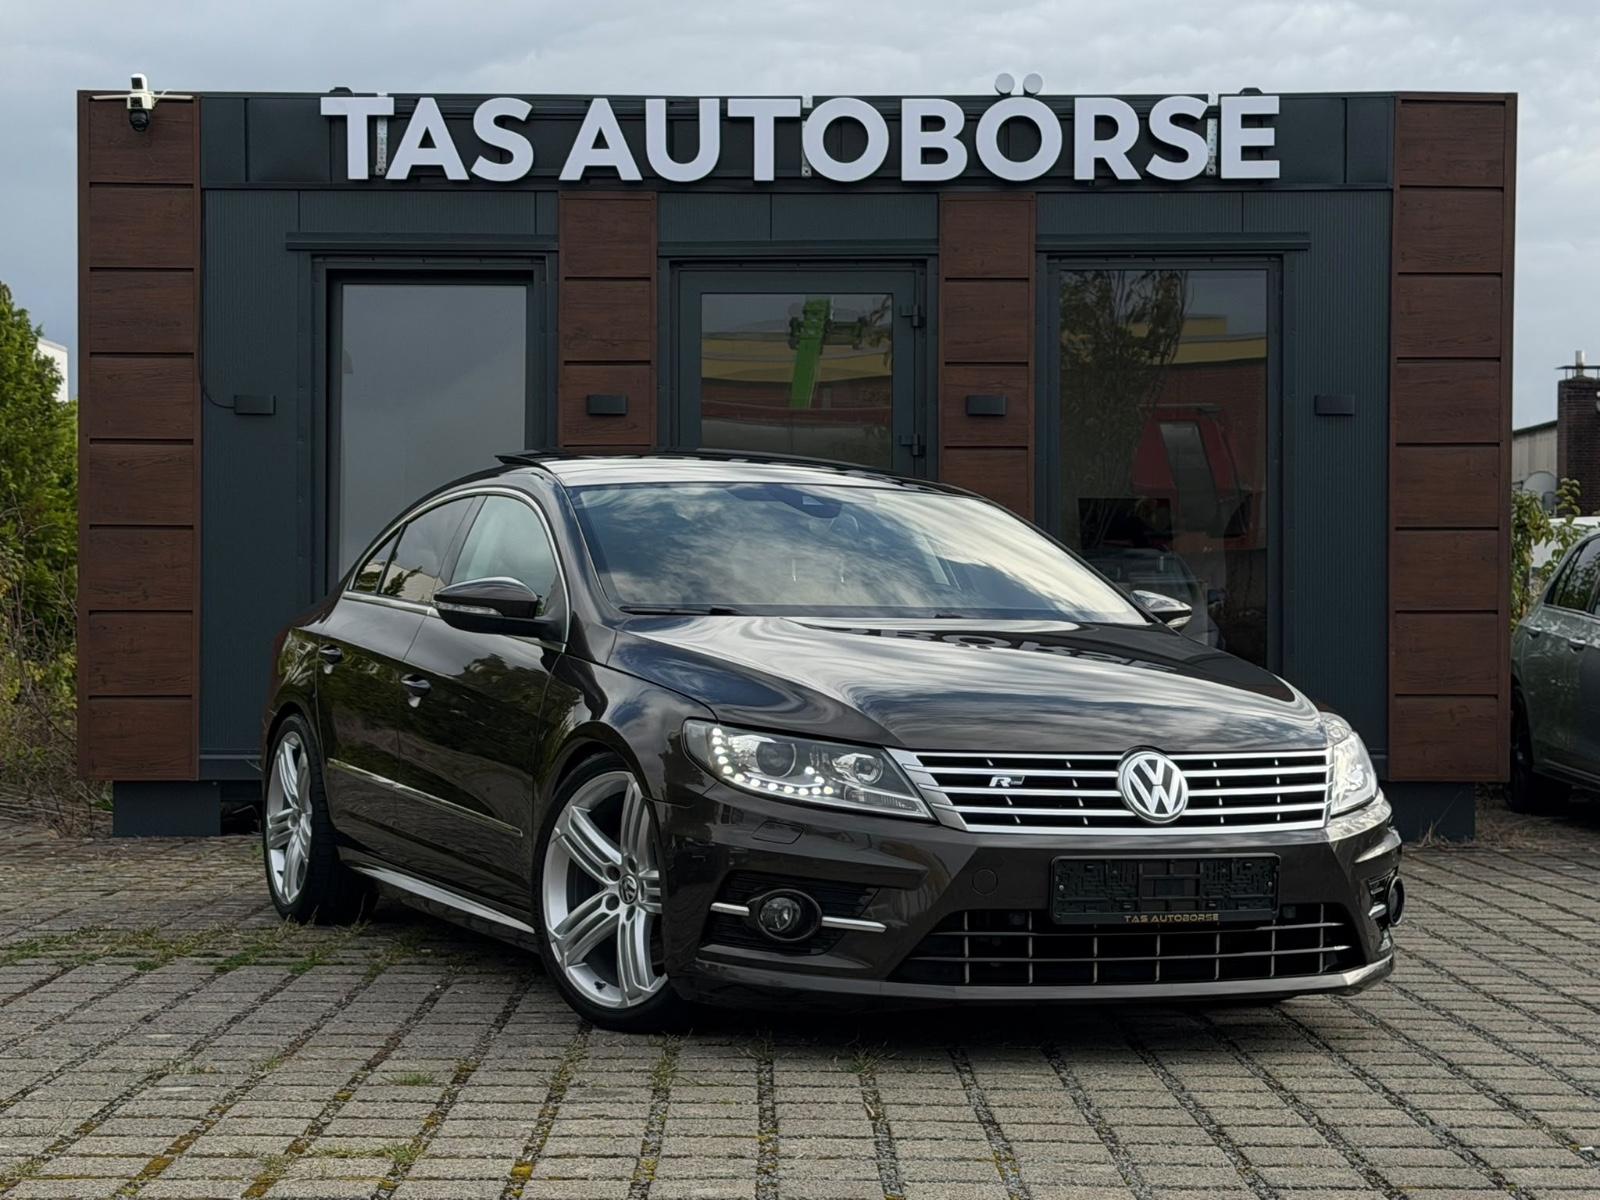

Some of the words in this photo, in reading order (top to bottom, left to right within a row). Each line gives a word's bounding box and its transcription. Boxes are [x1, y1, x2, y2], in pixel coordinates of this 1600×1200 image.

[320, 97, 534, 182] TAS
[558, 73, 1280, 182] AUTOBÖRSE
[1124, 754, 1186, 818] VW
[1124, 914, 1149, 924] TAS
